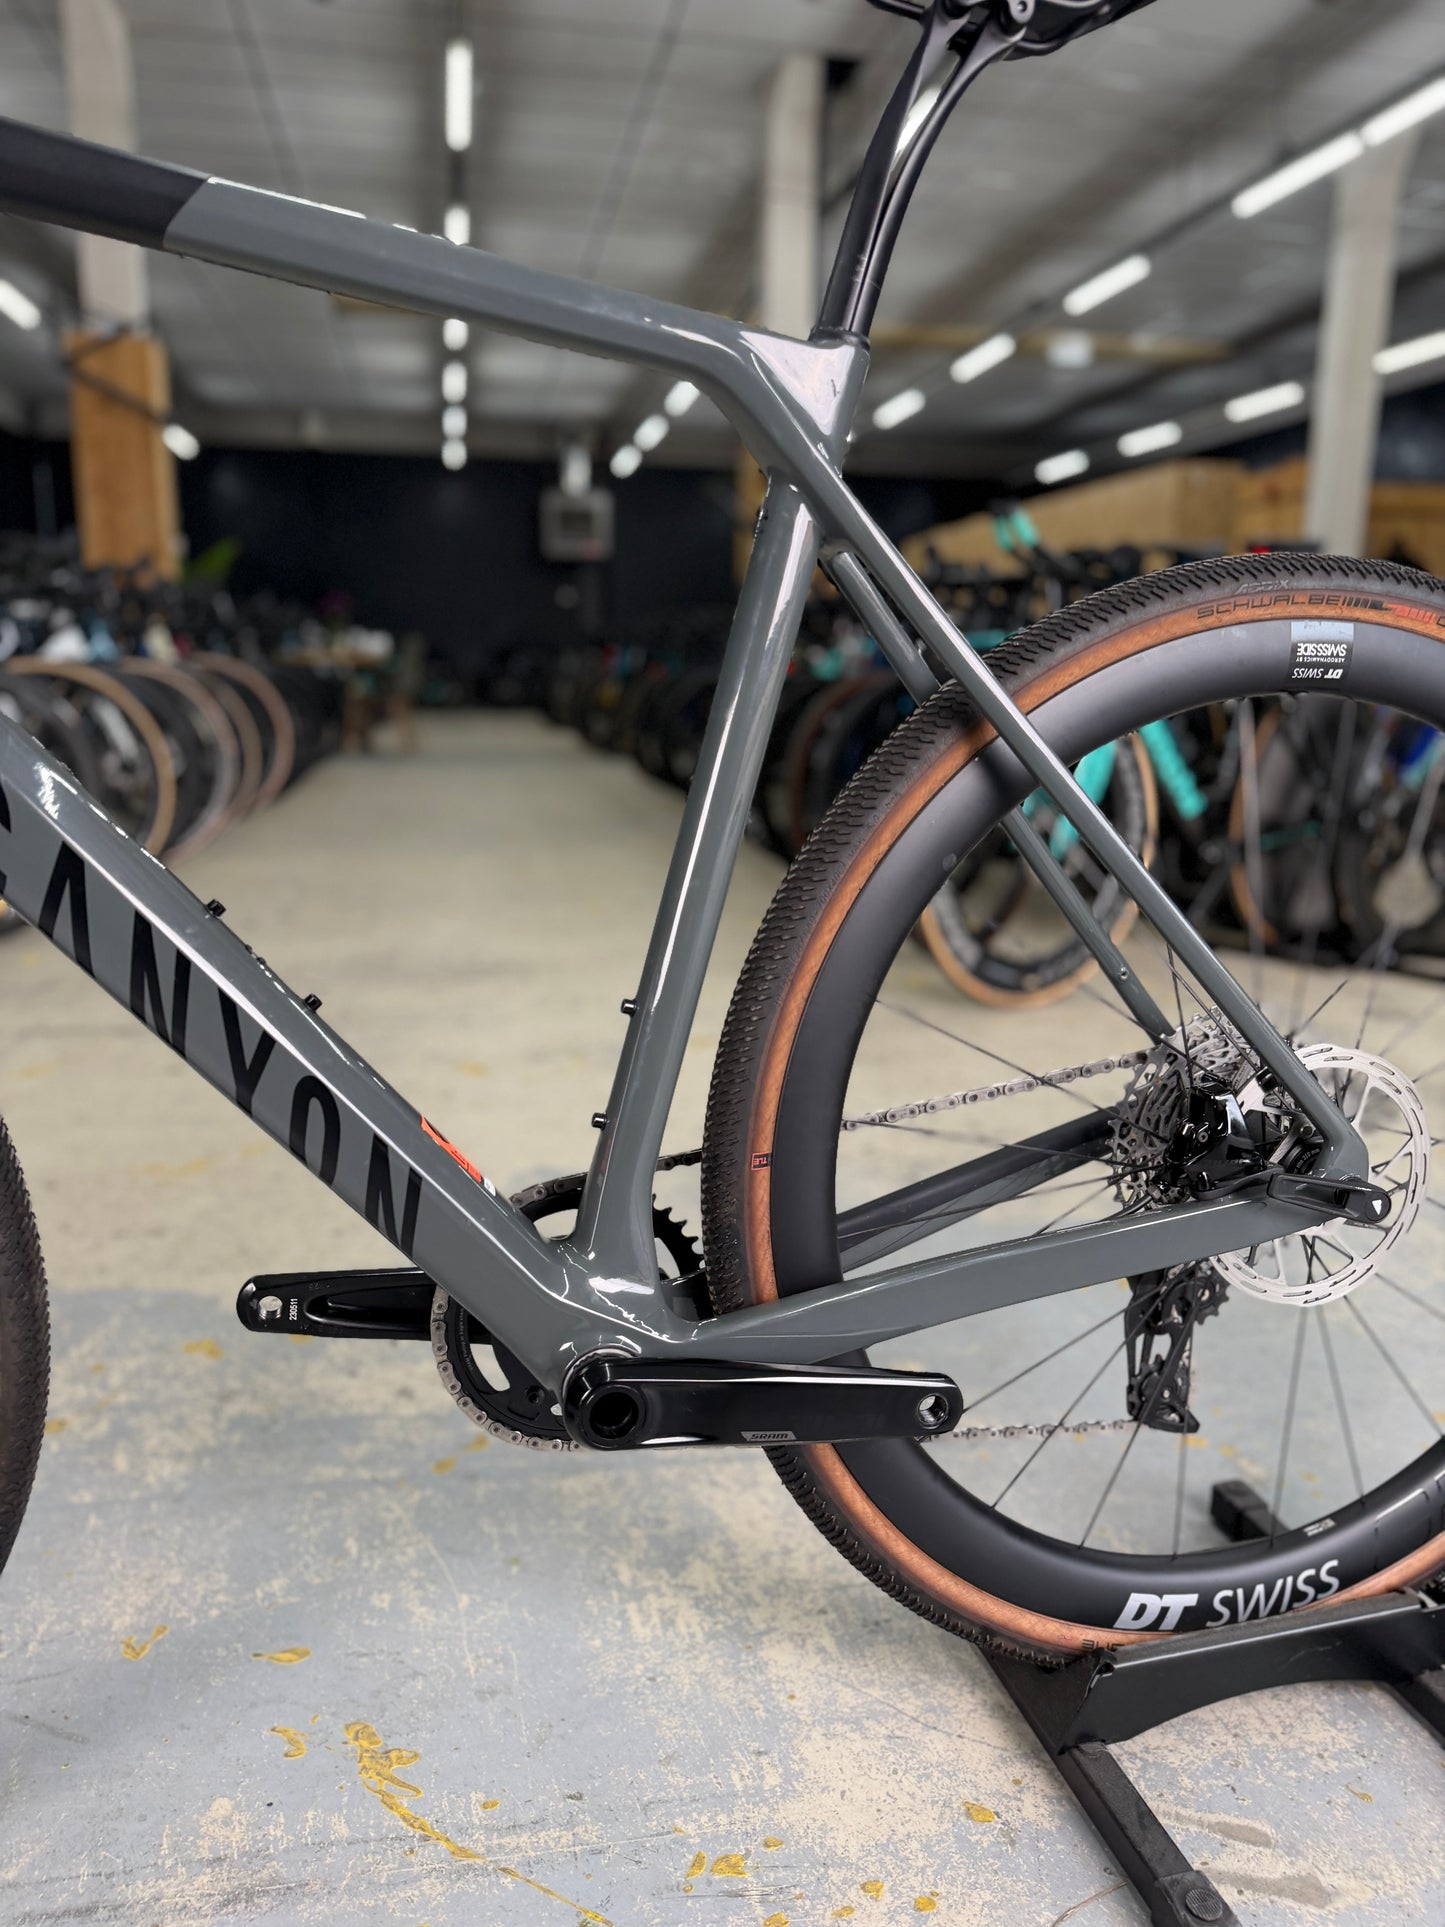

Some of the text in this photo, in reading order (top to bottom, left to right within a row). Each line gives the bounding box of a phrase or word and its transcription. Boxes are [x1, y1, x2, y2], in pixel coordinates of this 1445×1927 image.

[1197, 594, 1340, 618] SCHWALBE
[1291, 667, 1343, 680] DT SWISS
[0, 772, 423, 1262] ANYON
[289, 1298, 298, 1321] 230511
[1113, 1558, 1340, 1632] DT SWISS
